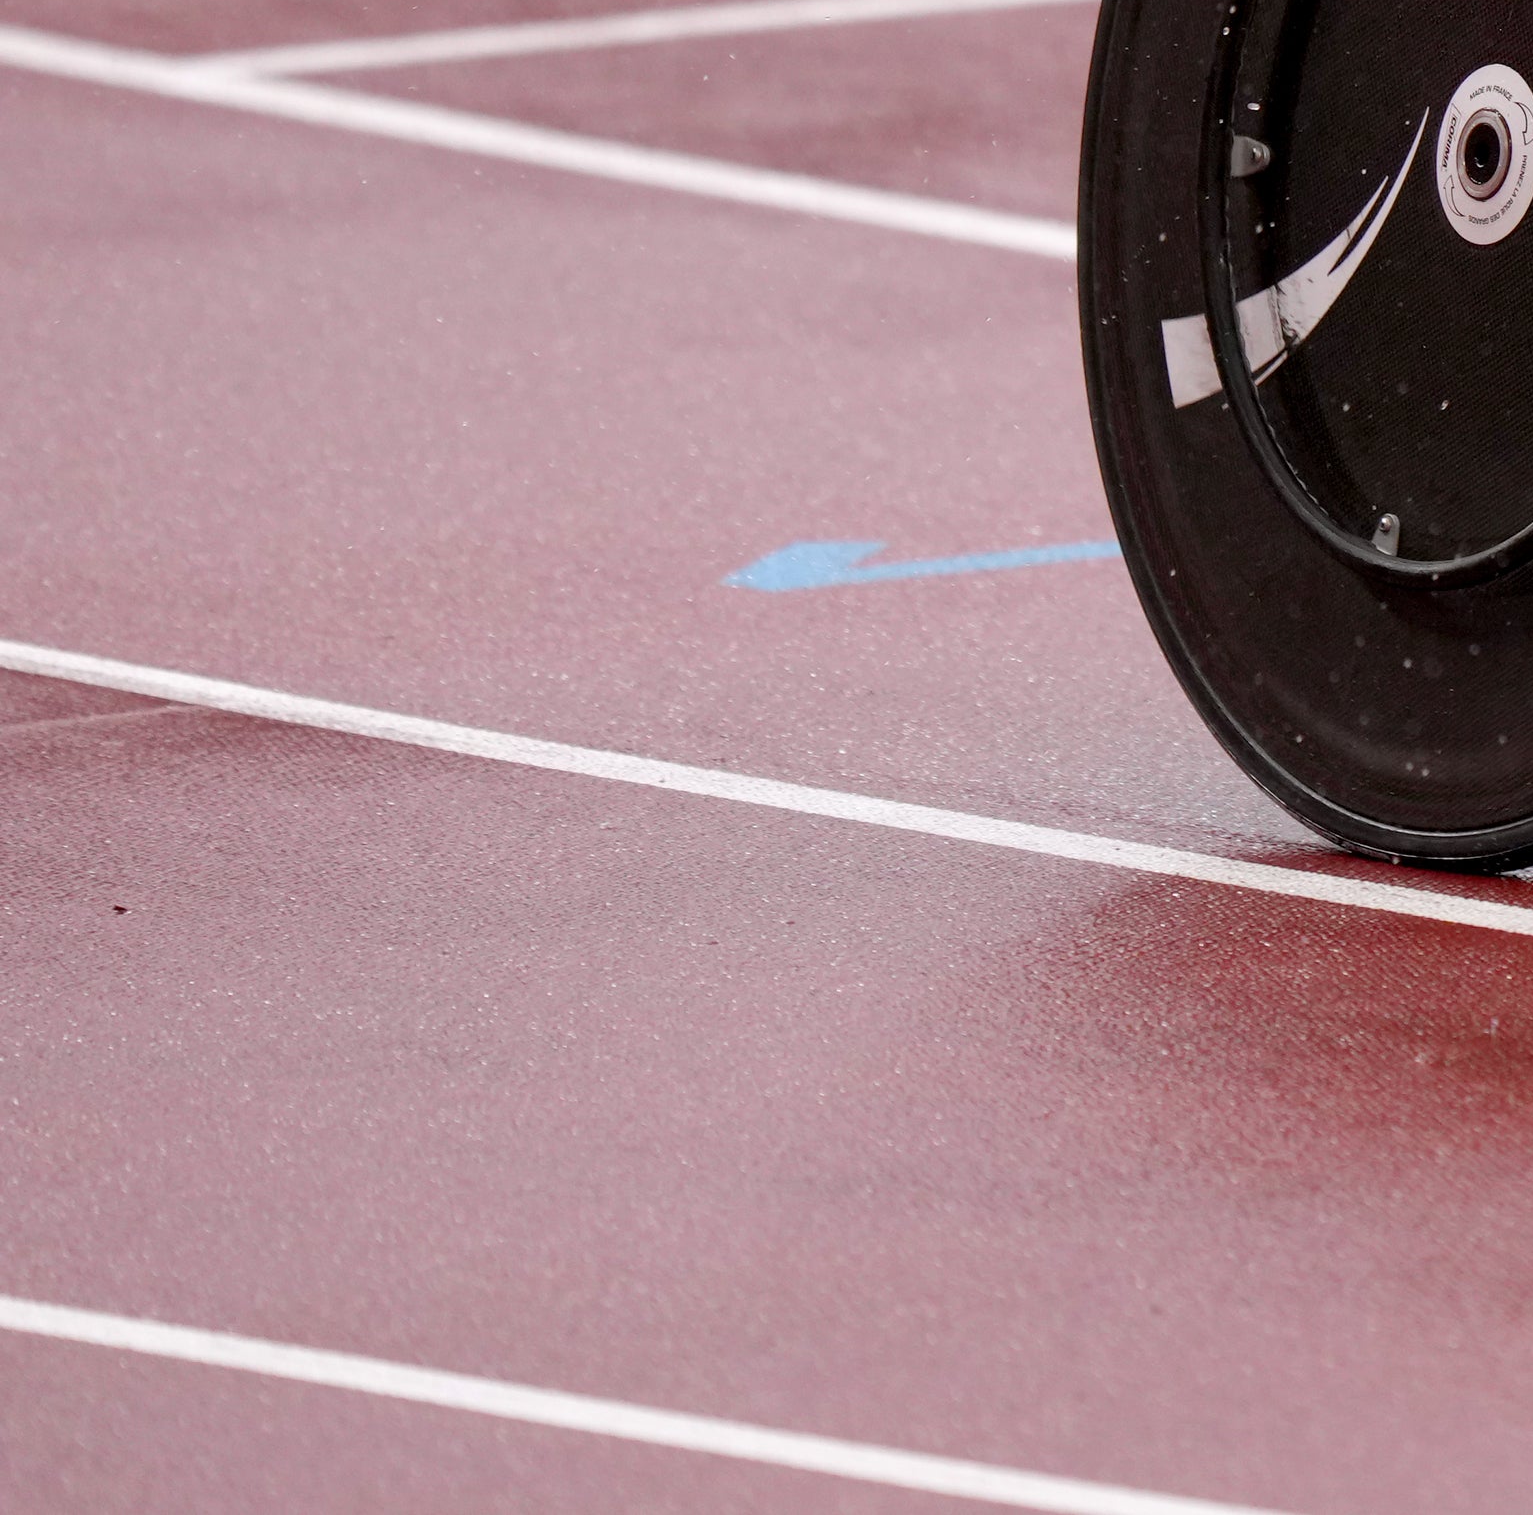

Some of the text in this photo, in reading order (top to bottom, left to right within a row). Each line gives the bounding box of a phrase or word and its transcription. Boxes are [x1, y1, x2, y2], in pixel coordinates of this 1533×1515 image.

[1469, 85, 1485, 102] MADE
[1493, 85, 1513, 102] FRANCE
[1442, 115, 1458, 169] CORIMA
